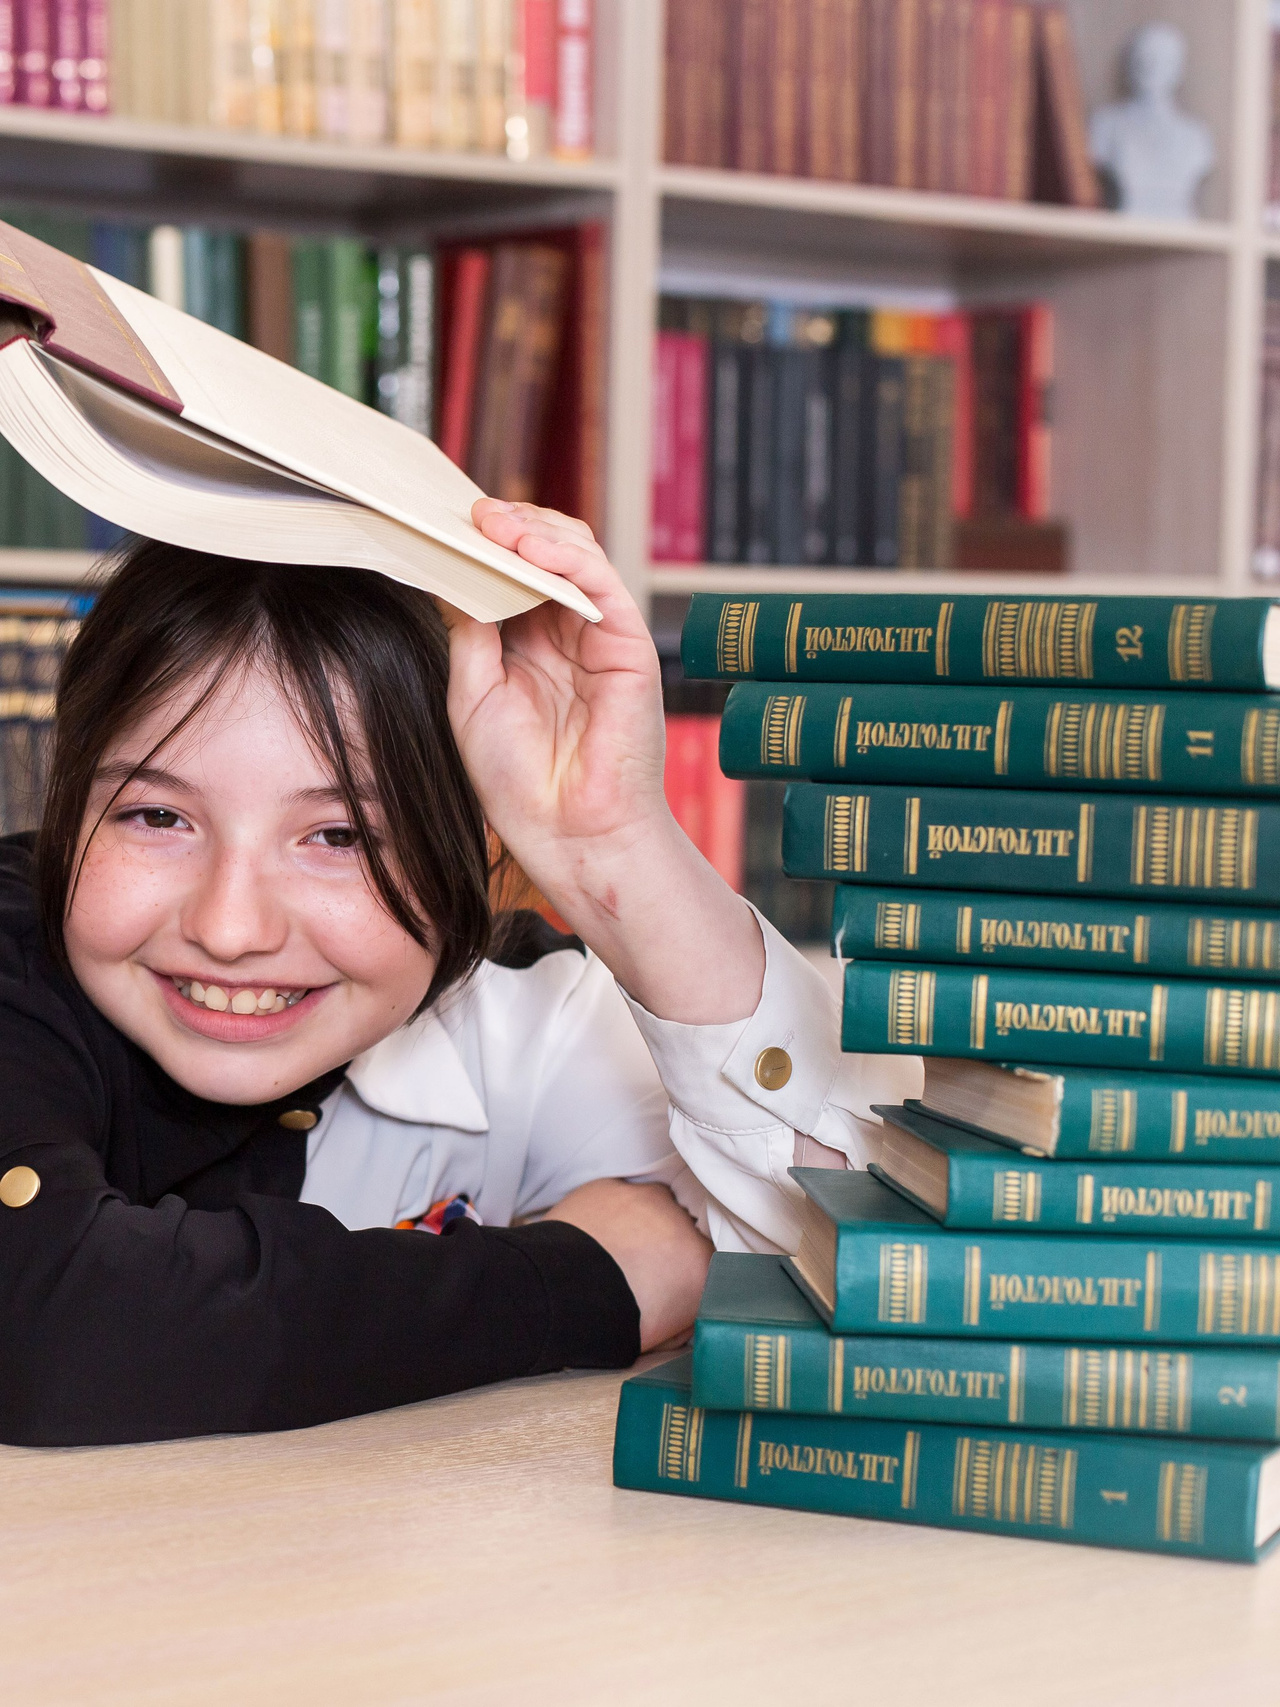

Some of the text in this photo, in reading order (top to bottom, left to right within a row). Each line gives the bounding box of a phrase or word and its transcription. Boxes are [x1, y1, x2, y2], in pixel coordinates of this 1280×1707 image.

[804, 626, 933, 659] Л.Н.ТОЛСТОЙ
[1115, 624, 1144, 662] 12
[856, 721, 992, 754] Л.Н.ТОЛСТОЙ
[1185, 730, 1215, 758] 11
[926, 824, 1075, 859] Л.Н.ТОЛСТОЙ
[980, 918, 1131, 953] Л.Н.ТОЛСТОЙ
[994, 1001, 1147, 1036] Л.Н.ТОЛСТОЙ
[1218, 1385, 1248, 1407] 2
[758, 1441, 899, 1484] Л.Н.ТОЛСТОЙ
[1100, 1489, 1129, 1504] 1
